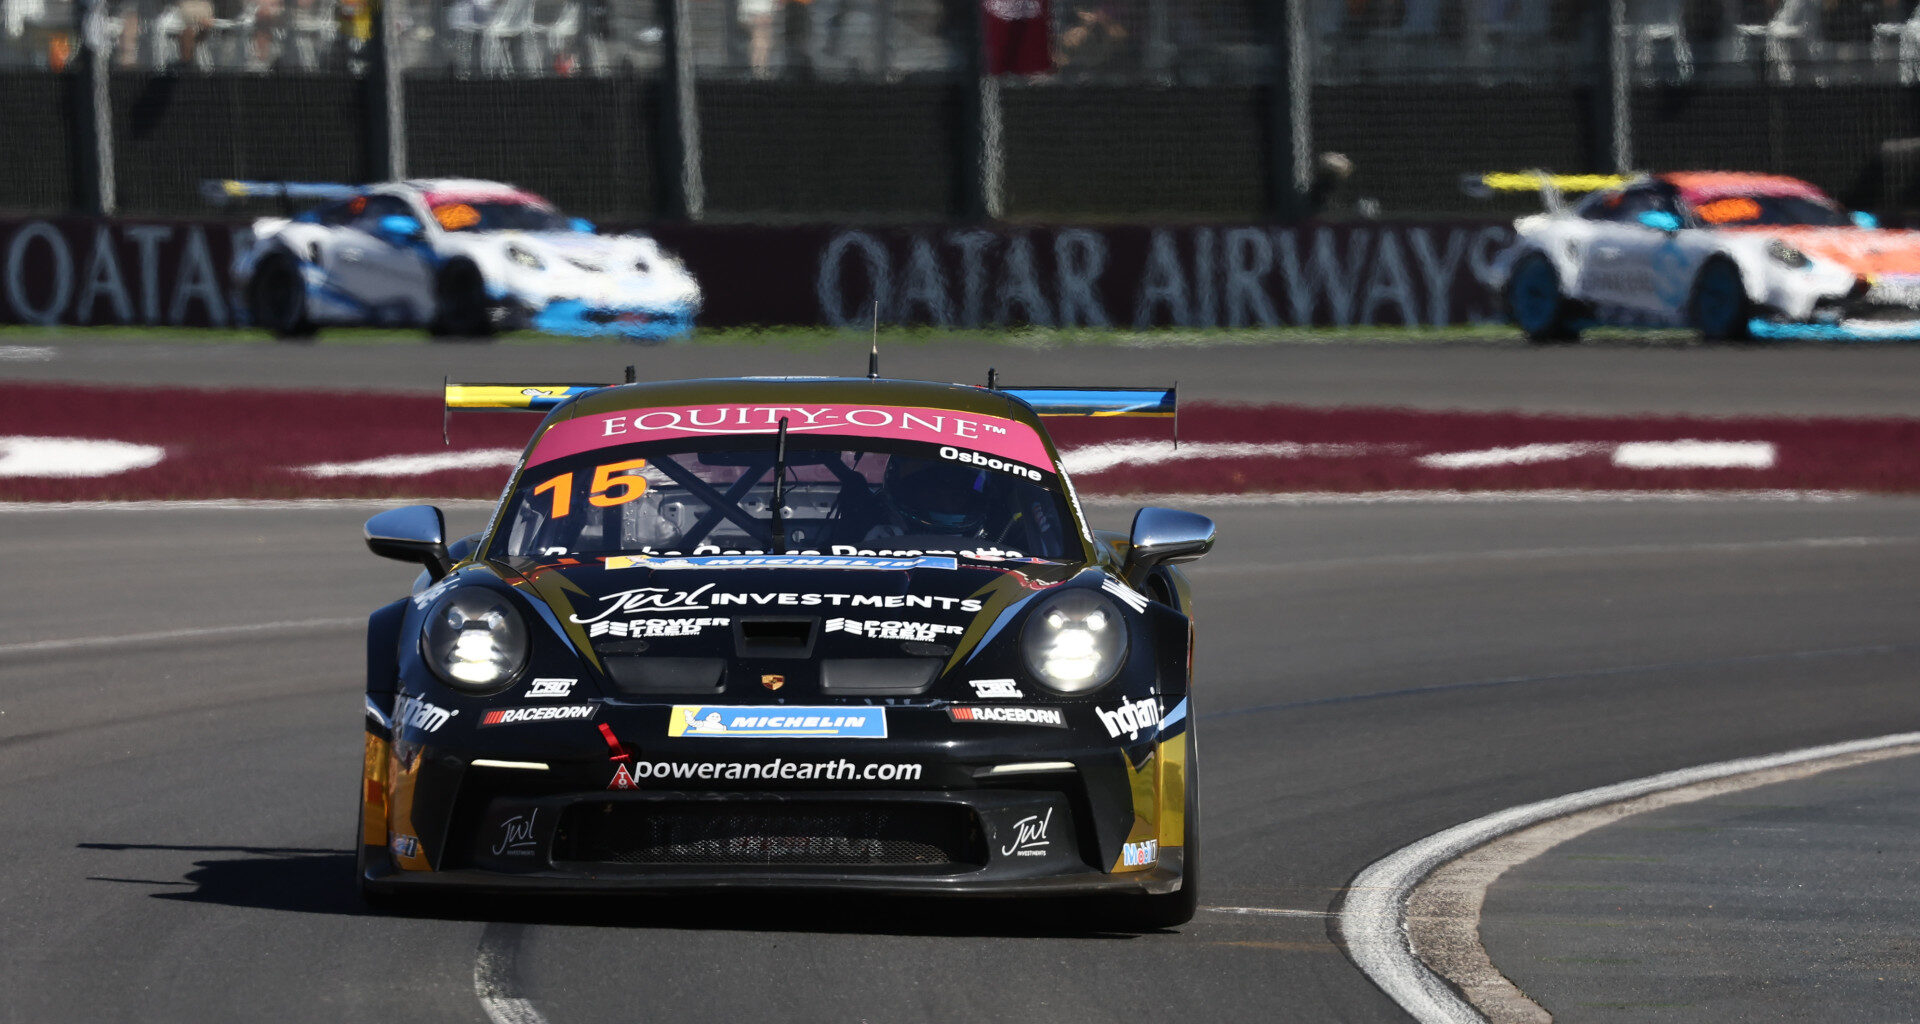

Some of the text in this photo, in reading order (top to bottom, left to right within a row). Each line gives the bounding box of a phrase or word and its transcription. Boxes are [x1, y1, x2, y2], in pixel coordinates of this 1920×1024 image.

[816, 225, 1108, 328] QATAR
[939, 446, 1042, 482] Osborne
[534, 459, 647, 519] 15
[705, 558, 926, 567] MICHELIN
[711, 592, 982, 612] INVESTMENTS
[629, 617, 731, 628] POWER
[863, 620, 964, 635] POWER
[500, 705, 594, 723] RACEBORN
[730, 716, 866, 728] MICHELIN
[972, 707, 1061, 725] RACEBORN
[634, 758, 922, 783] powerandearth.com
